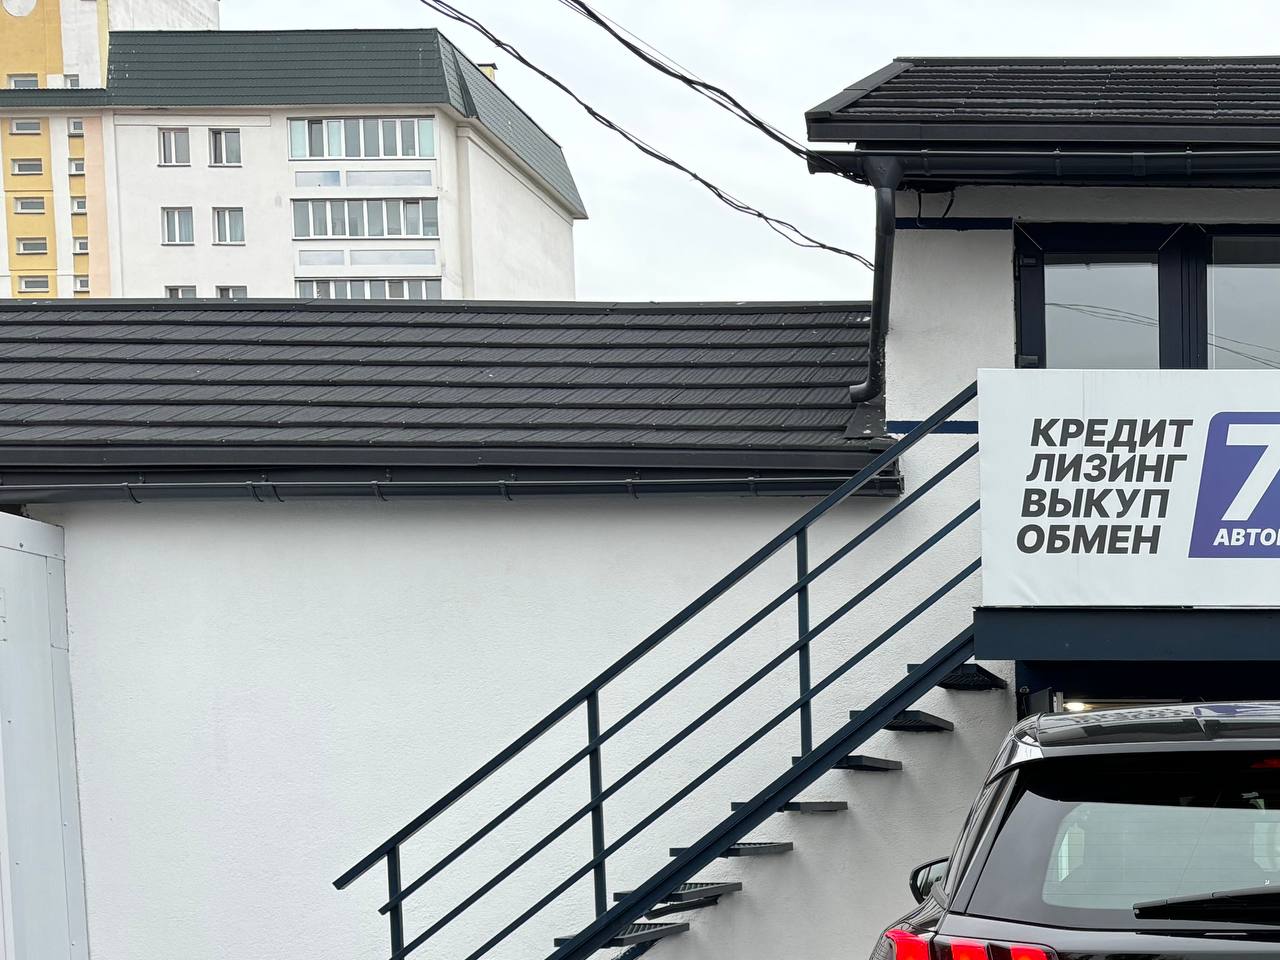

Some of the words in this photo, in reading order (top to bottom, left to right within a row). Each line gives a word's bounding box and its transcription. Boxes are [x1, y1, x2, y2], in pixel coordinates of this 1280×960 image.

[1030, 418, 1194, 453] КРЕДИТ
[1025, 453, 1188, 482] ЛИЗИНГ
[1021, 488, 1170, 518] ВЫКУП
[1016, 524, 1161, 554] ОБМЕН
